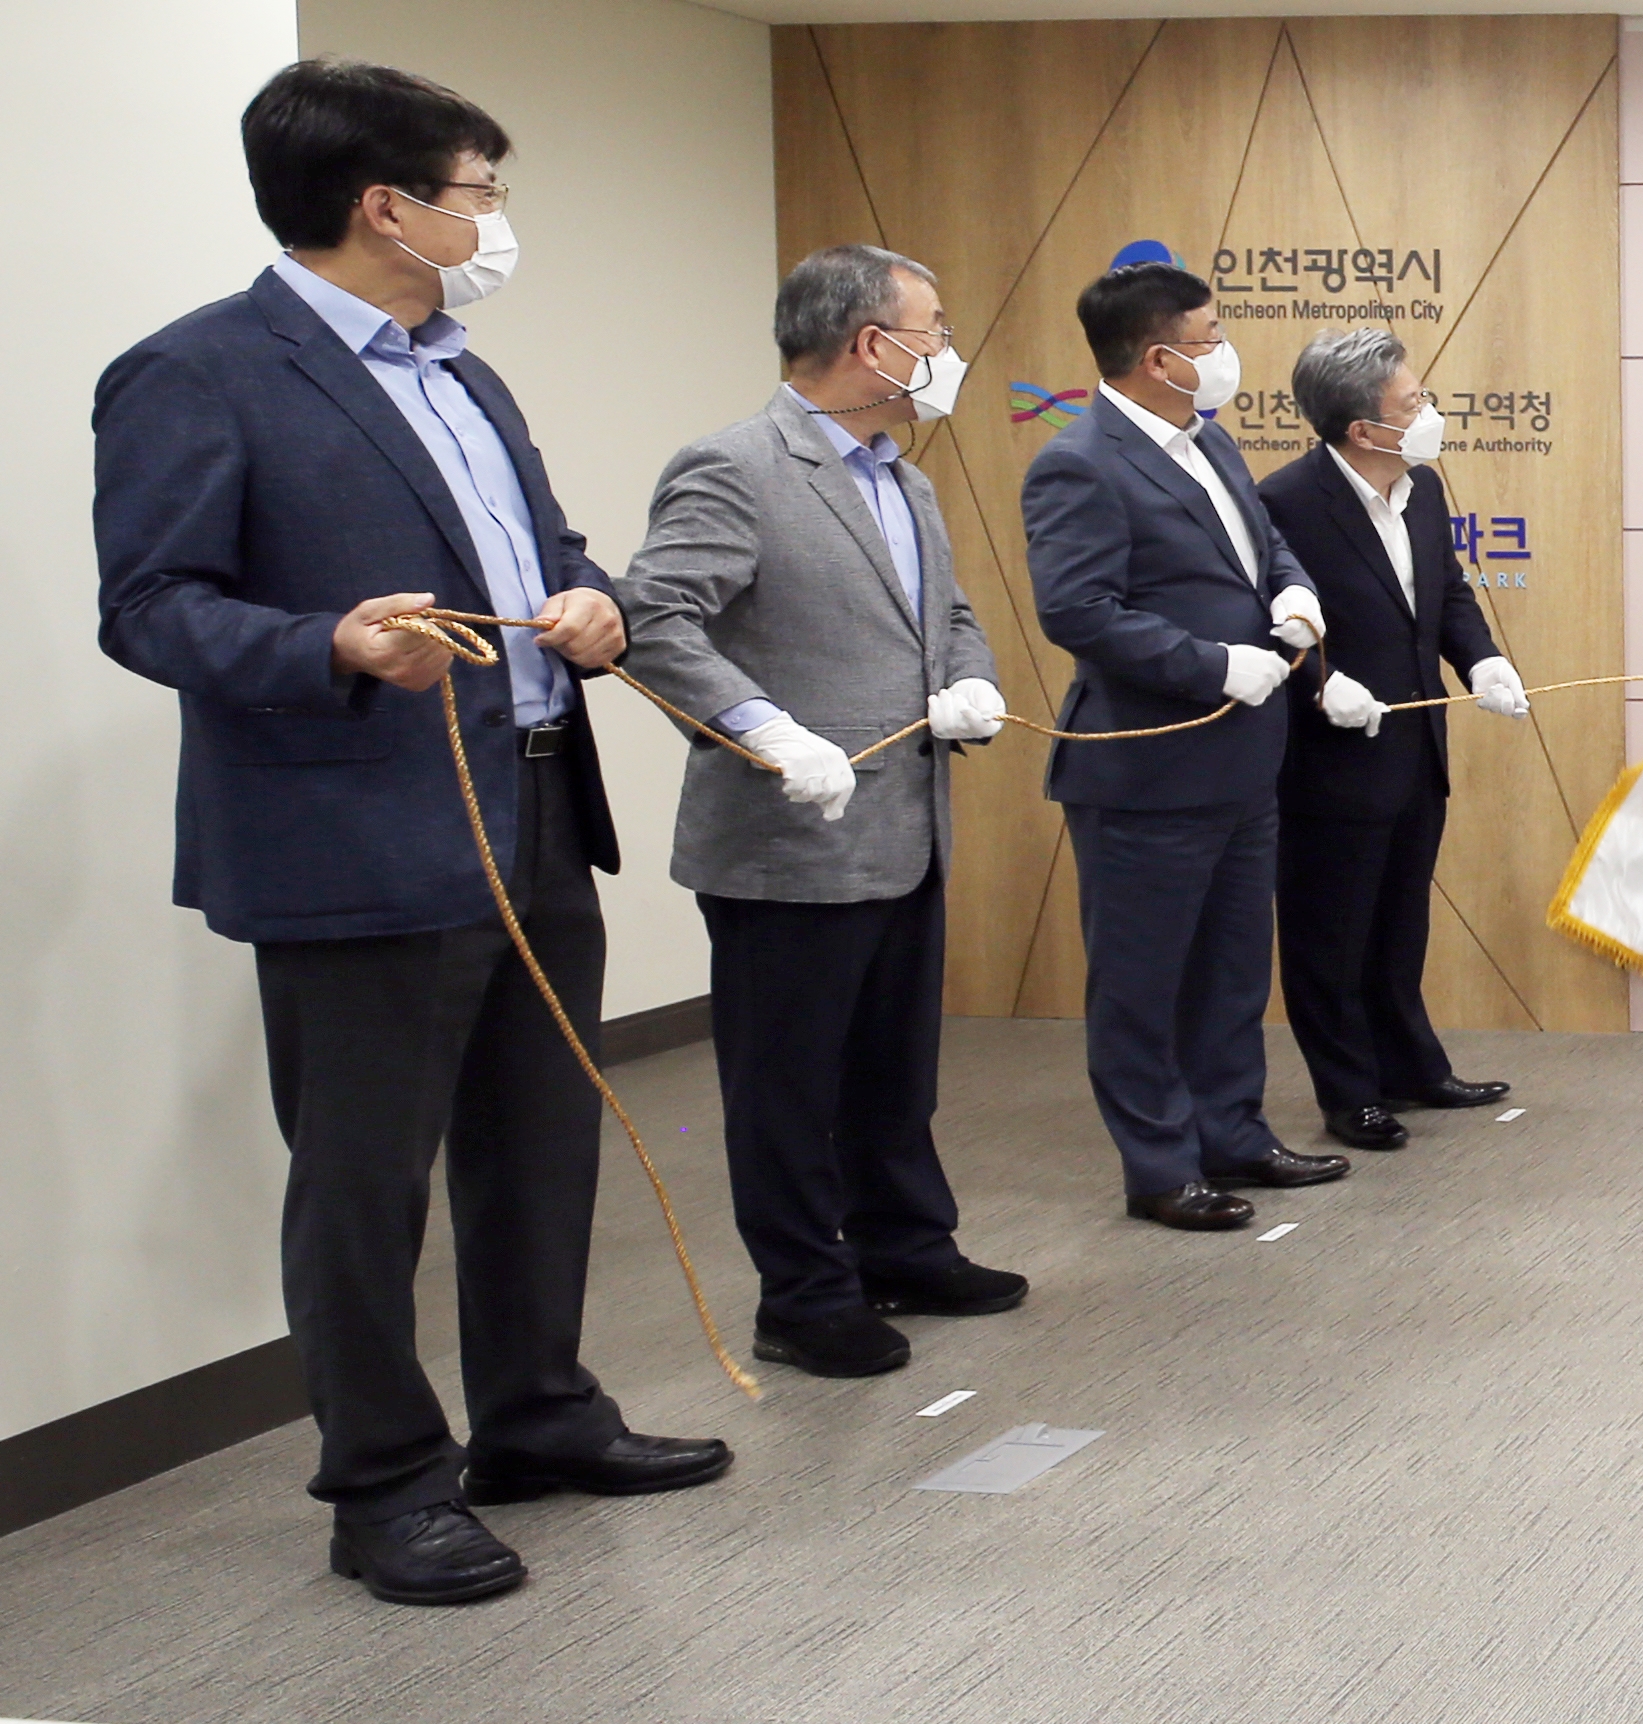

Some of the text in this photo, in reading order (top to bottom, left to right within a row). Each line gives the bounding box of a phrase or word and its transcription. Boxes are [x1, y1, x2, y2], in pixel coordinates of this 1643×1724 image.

[1213, 247, 1441, 293] 인천광역시
[1217, 300, 1443, 323] Incheon Metropolitan City
[1237, 436, 1300, 451] Incheon
[1473, 437, 1552, 455] Authority
